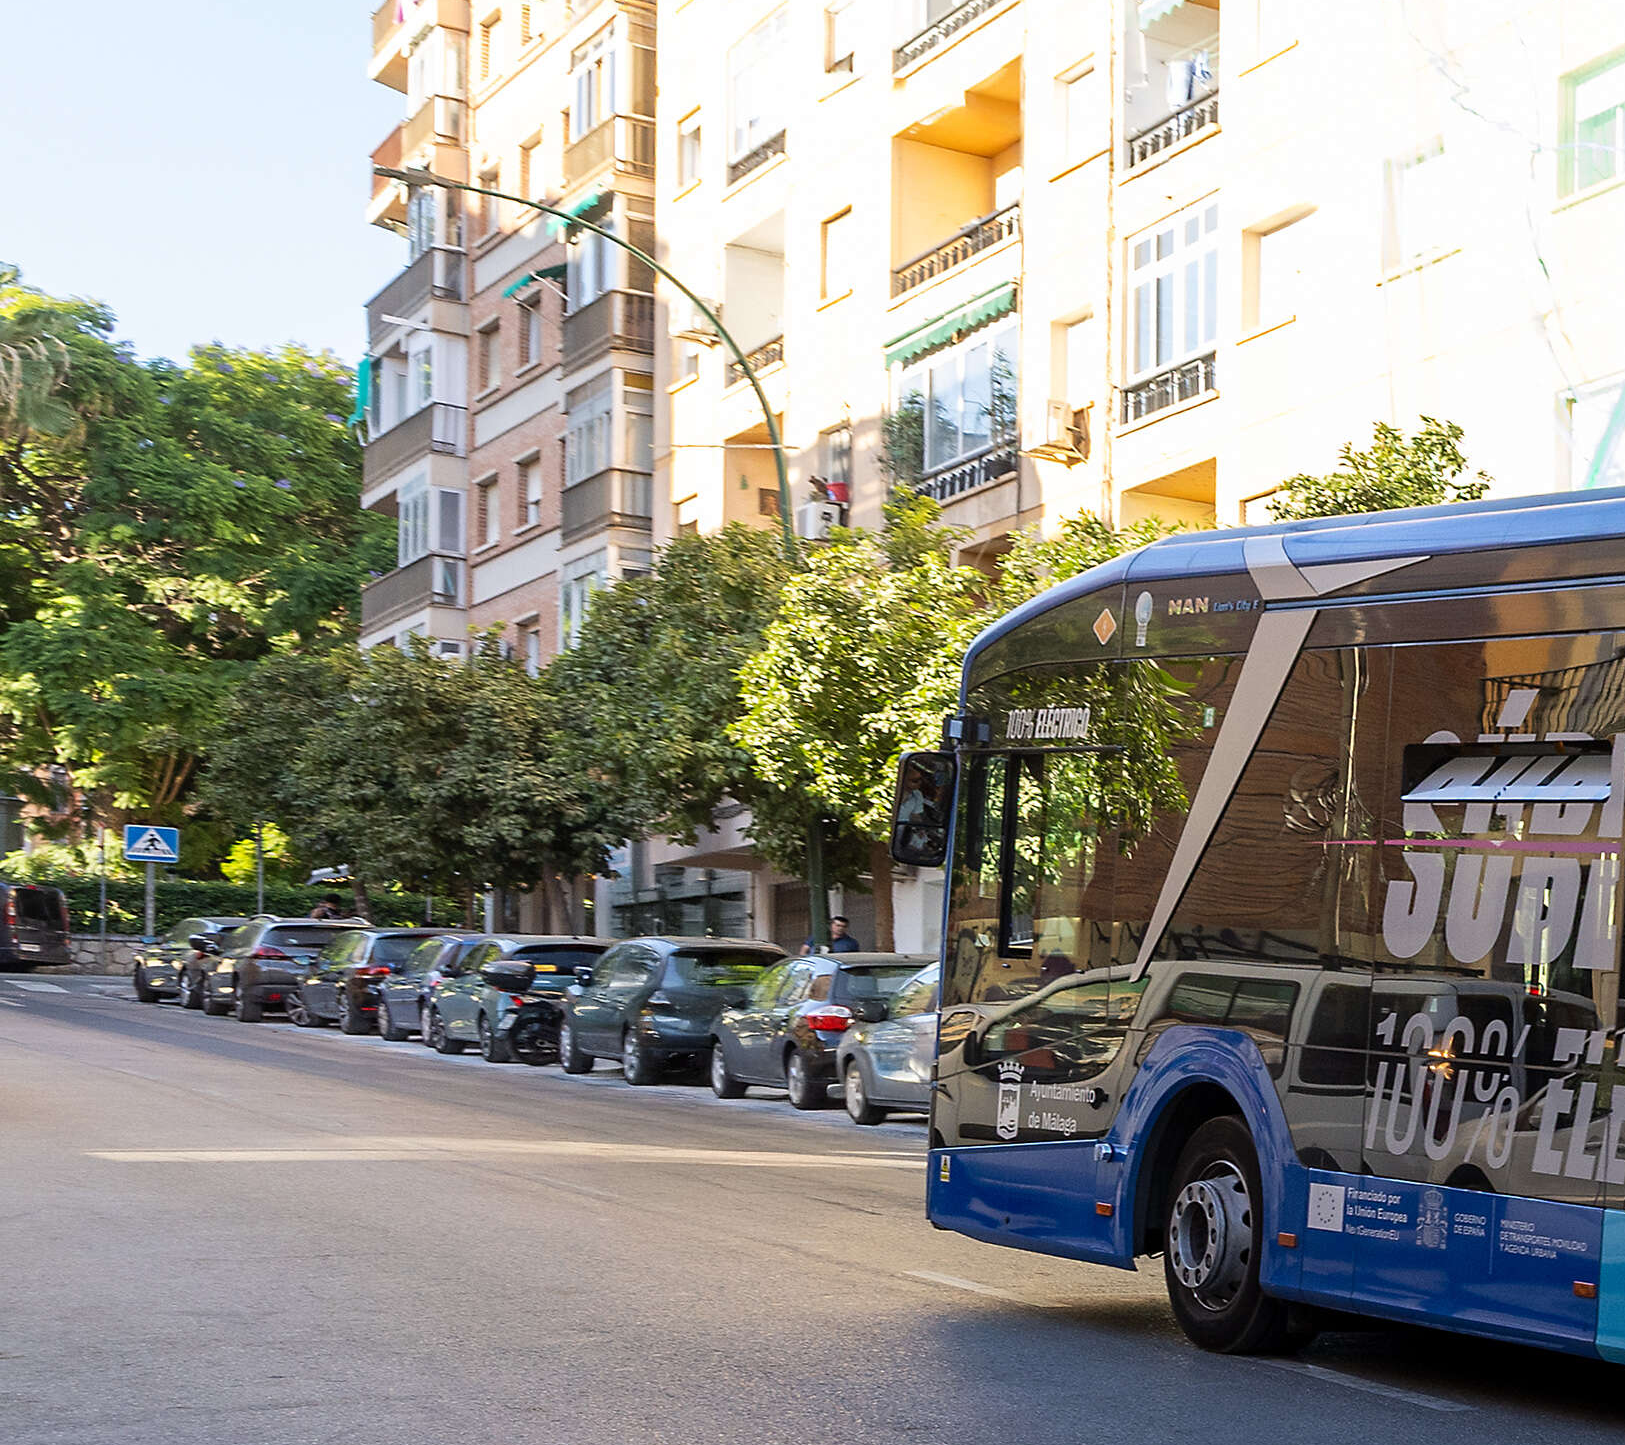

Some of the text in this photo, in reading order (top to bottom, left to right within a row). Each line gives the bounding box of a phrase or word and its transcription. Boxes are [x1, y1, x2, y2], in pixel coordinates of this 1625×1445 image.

[1167, 597, 1209, 616] MAN
[1006, 704, 1092, 739] 100% ELÉCTRICO
[1029, 1080, 1097, 1104] Ayuntamiento
[1365, 1010, 1531, 1171] 100%
[1028, 1112, 1078, 1136] de Málaga
[1347, 1187, 1402, 1206] Financiado por
[1346, 1204, 1408, 1224] la Unión Europea
[1453, 1224, 1463, 1234] DE
